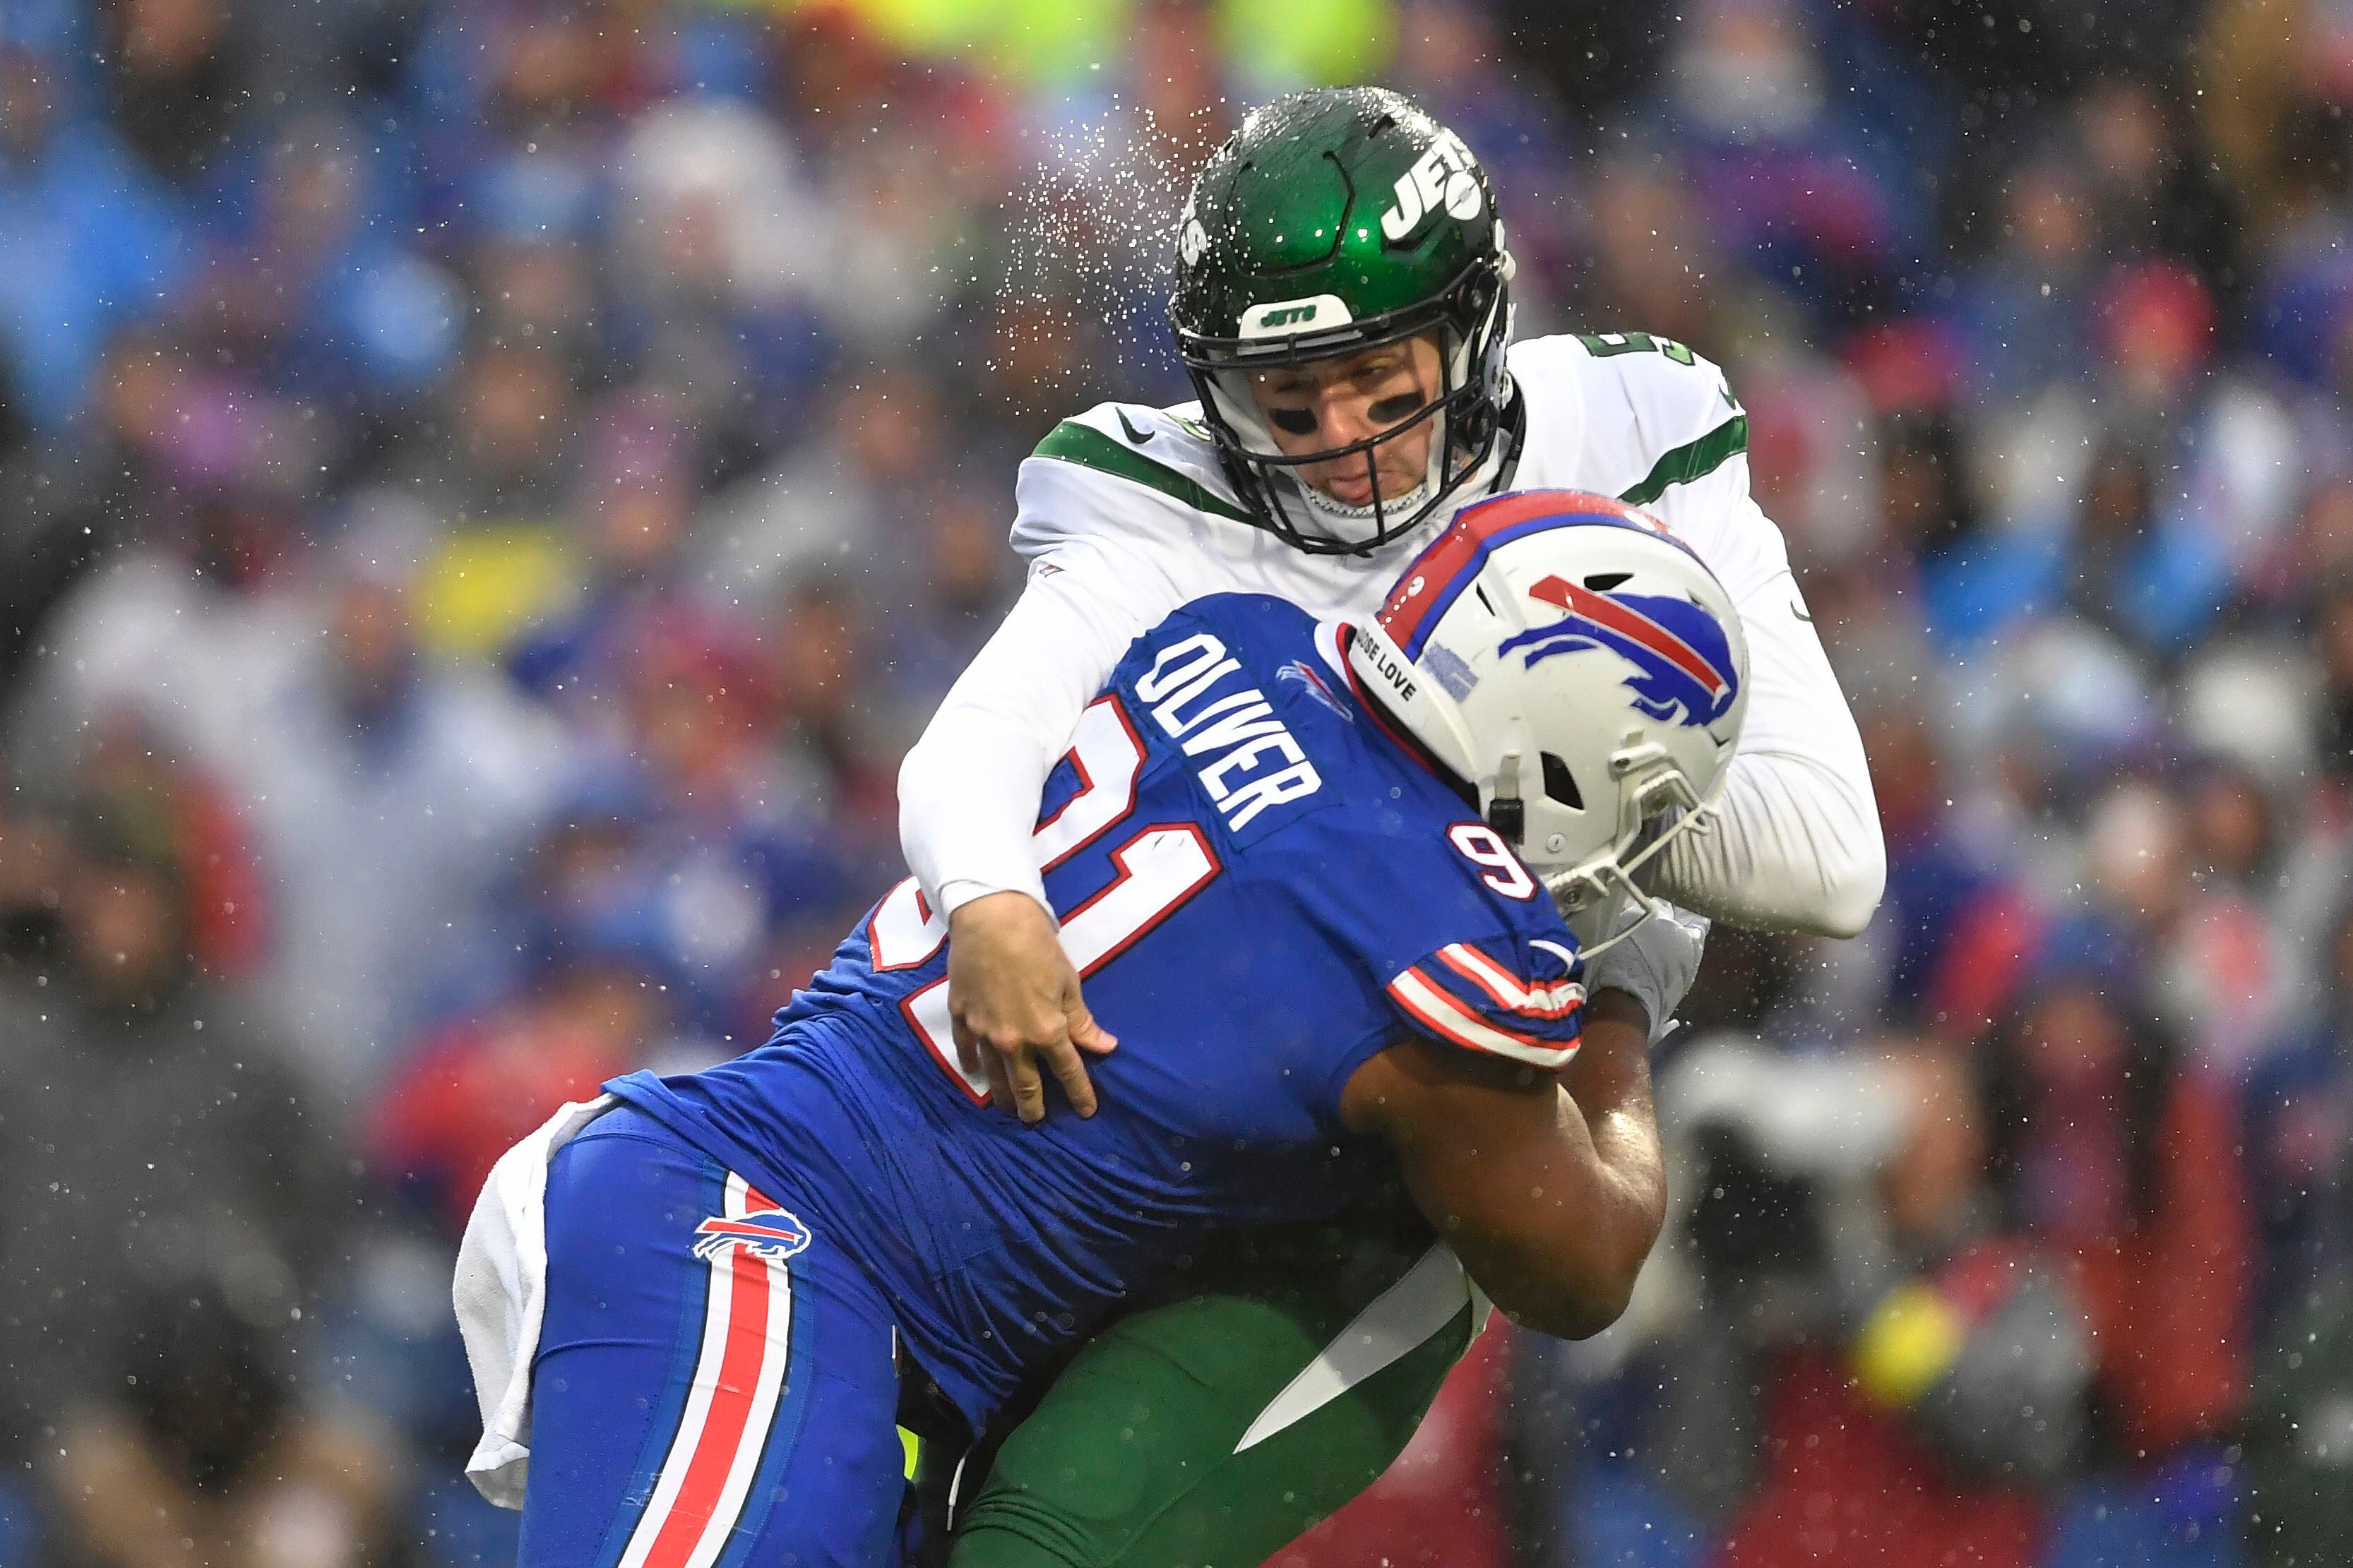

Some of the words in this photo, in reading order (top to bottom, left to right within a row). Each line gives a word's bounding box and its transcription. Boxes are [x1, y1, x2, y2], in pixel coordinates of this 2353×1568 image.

[1260, 304, 1317, 327] JETS
[1376, 653, 1417, 702] LOVE
[1134, 633, 1323, 832] OLIVER
